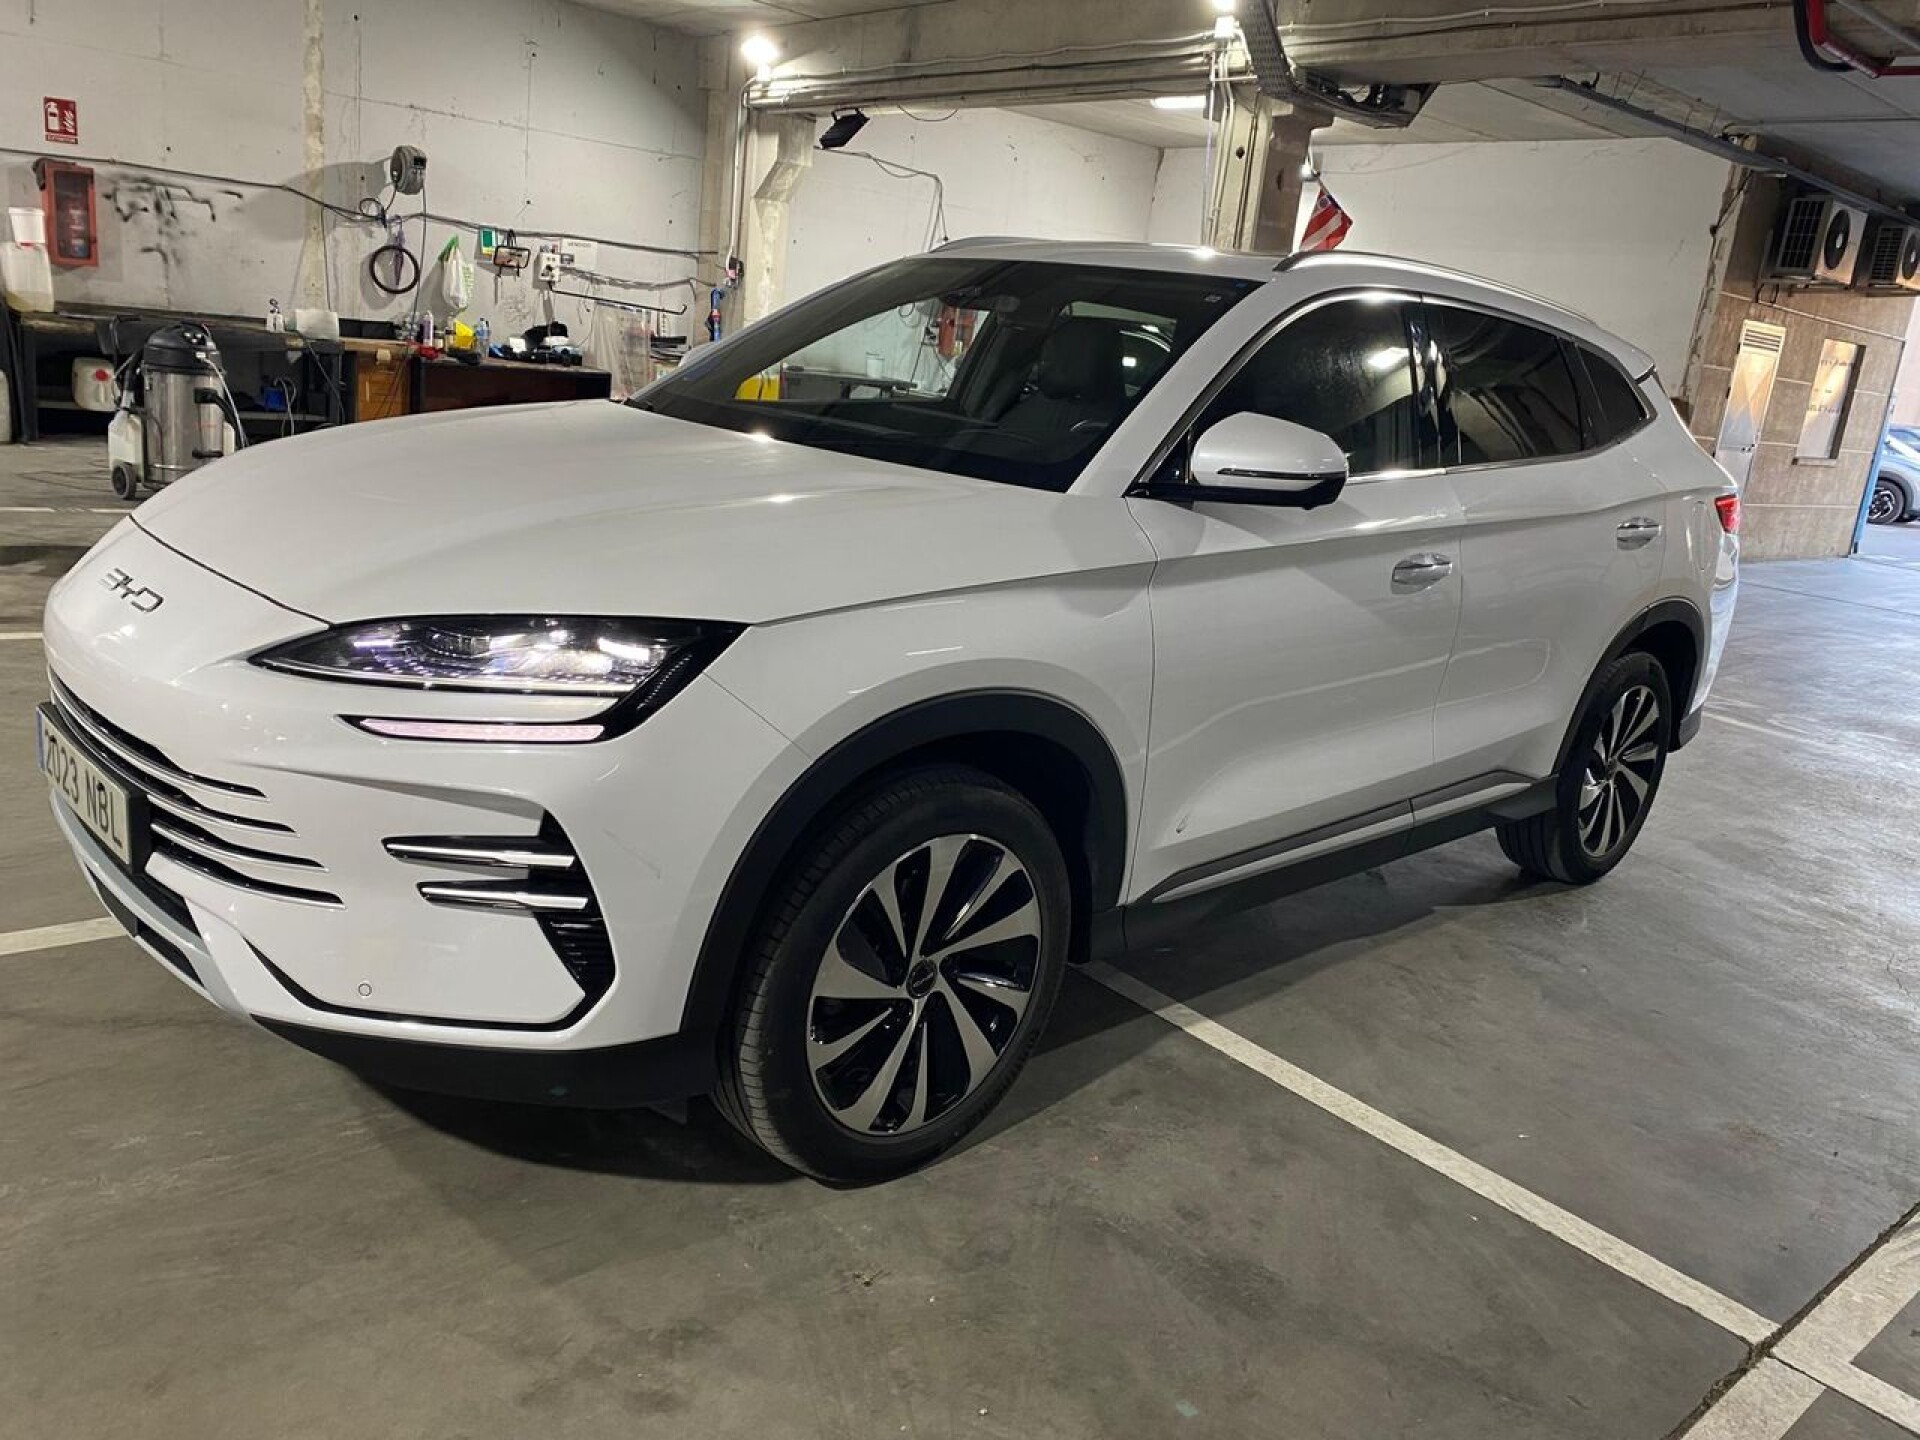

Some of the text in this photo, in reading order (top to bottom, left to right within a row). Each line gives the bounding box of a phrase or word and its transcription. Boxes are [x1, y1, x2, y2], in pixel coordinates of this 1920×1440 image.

[101, 568, 164, 612] BYD
[45, 729, 123, 848] 2023 NBL
